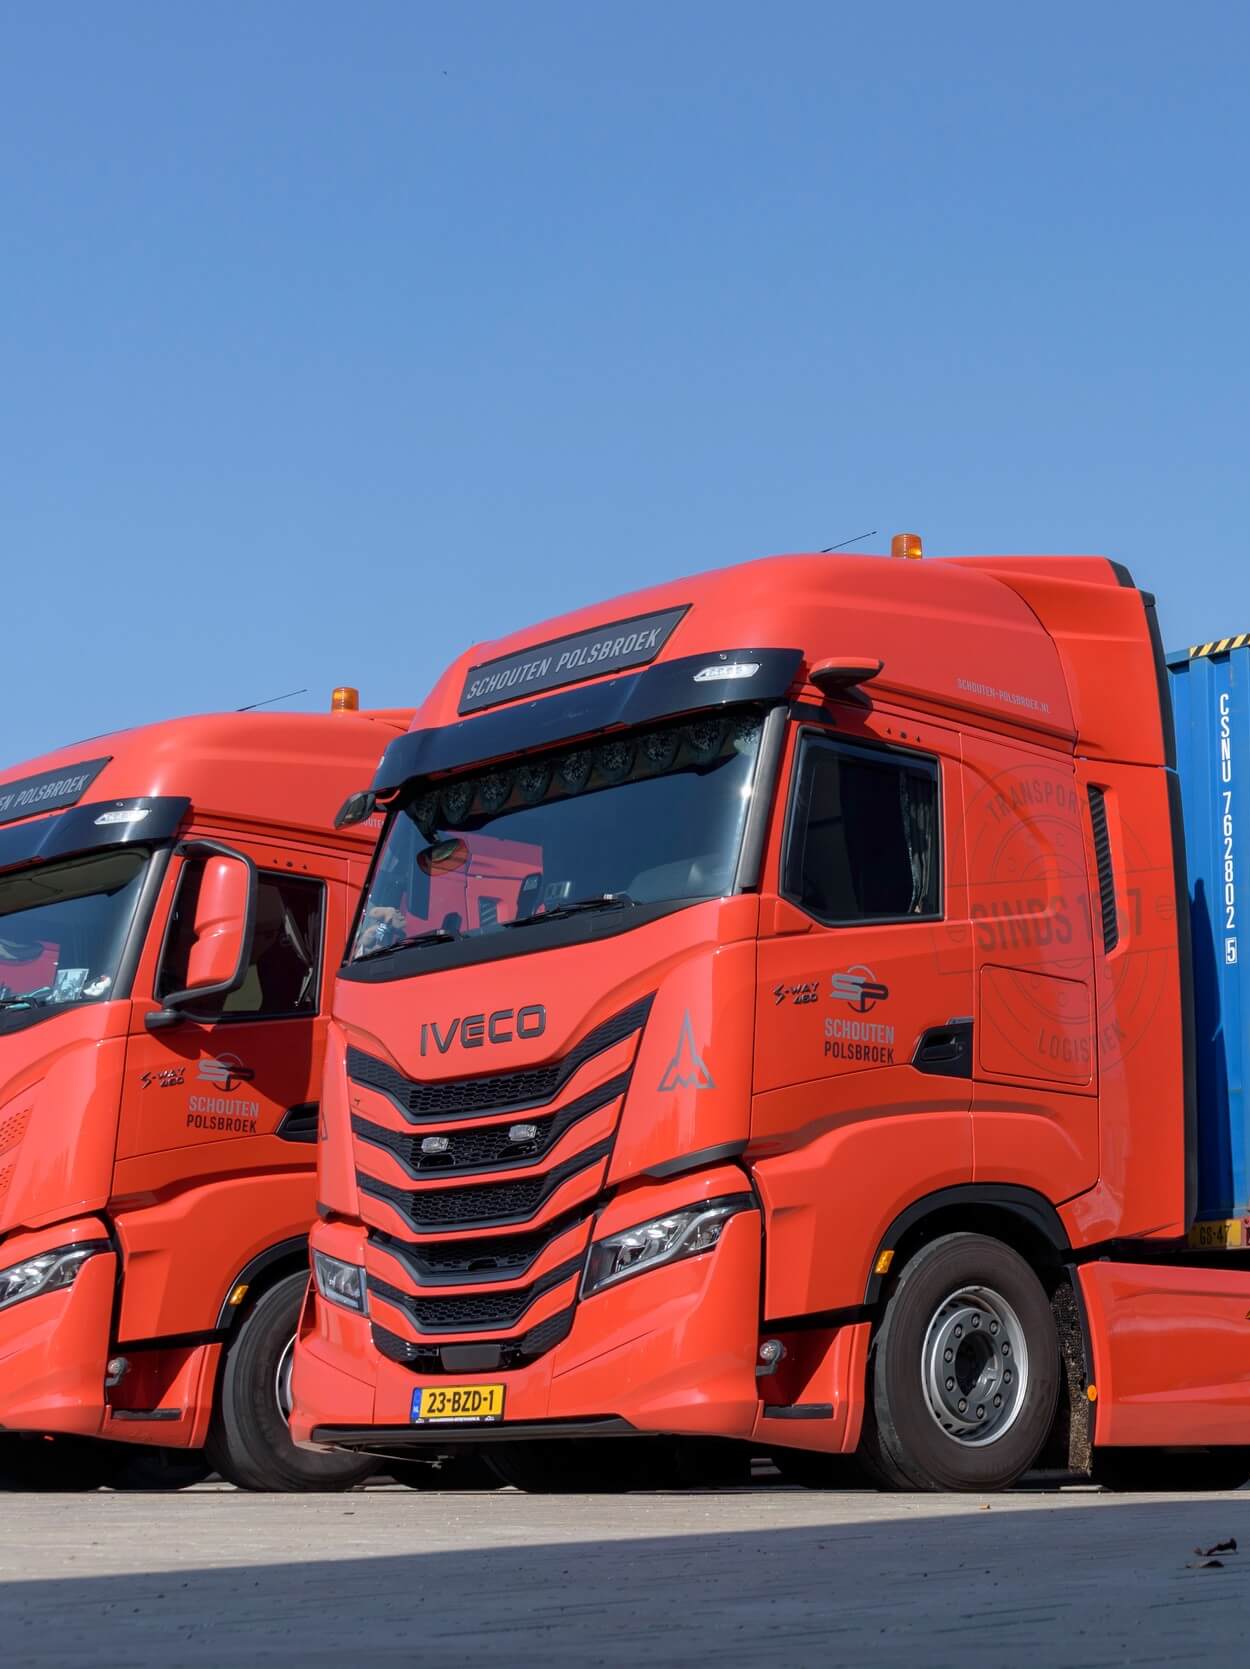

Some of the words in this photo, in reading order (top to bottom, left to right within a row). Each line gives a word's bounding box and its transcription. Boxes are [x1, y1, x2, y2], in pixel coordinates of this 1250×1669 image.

[466, 658, 552, 700] SCHOUTEN
[555, 627, 662, 673] POLSBROEK
[1219, 693, 1232, 783] CSNU
[14, 774, 90, 808] POLSBROEK
[1222, 790, 1235, 929] 762802
[970, 893, 1074, 952] SINDS
[1226, 938, 1236, 963] 5
[420, 1004, 547, 1057] IVECO
[824, 1018, 894, 1044] SCHOUTEN
[824, 1041, 894, 1064] POLSBROEK
[188, 1096, 260, 1117] SCHOUTEN
[186, 1114, 257, 1133] POLSBROEK
[427, 1390, 495, 1413] 23-BZD-1
